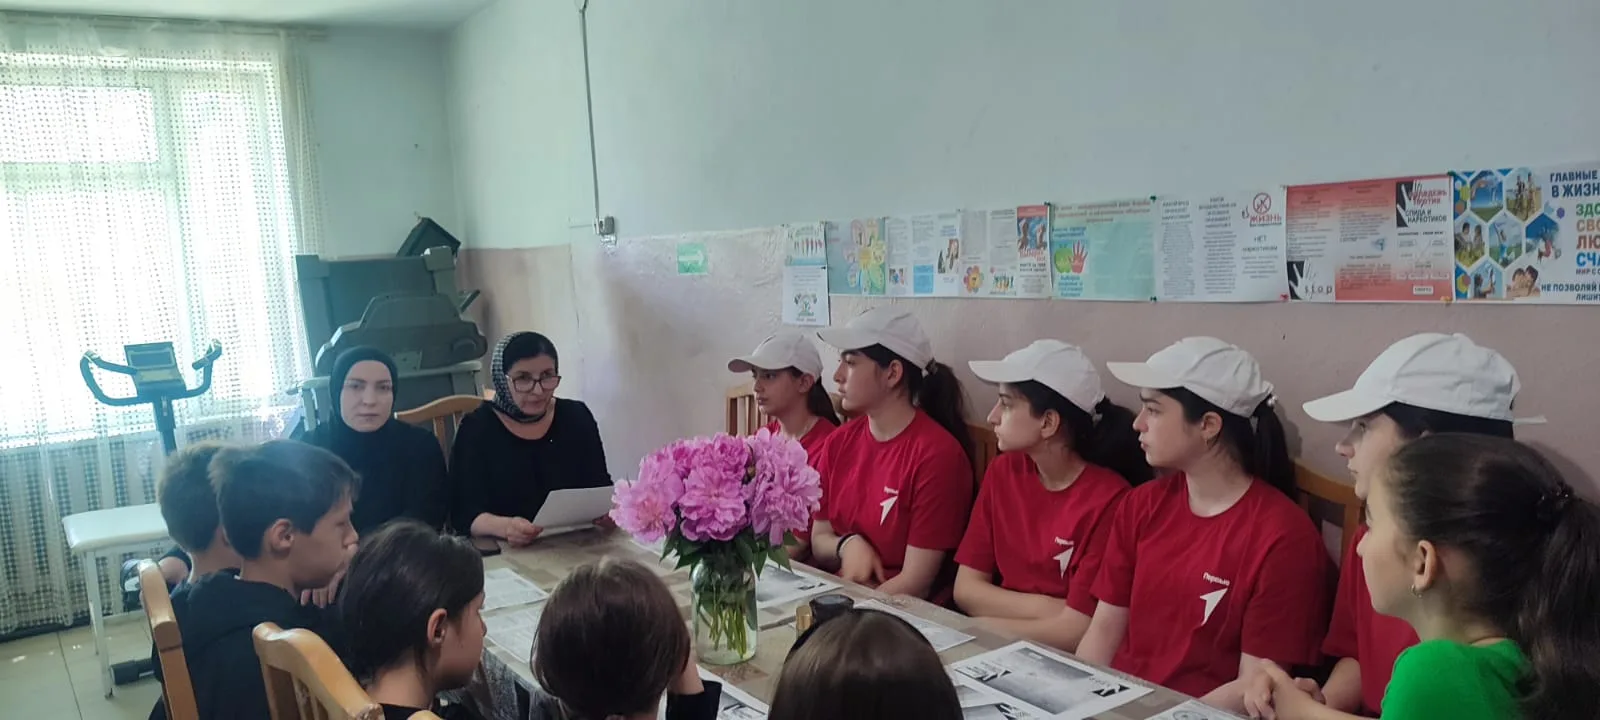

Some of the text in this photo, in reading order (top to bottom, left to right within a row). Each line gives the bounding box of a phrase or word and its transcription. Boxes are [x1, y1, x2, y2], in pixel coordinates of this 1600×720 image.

[1550, 170, 1598, 183] ГЛАВНЫЕ
[1551, 184, 1560, 198] В
[1541, 281, 1597, 292] НЕ ПОЗВОЛЯЙ
